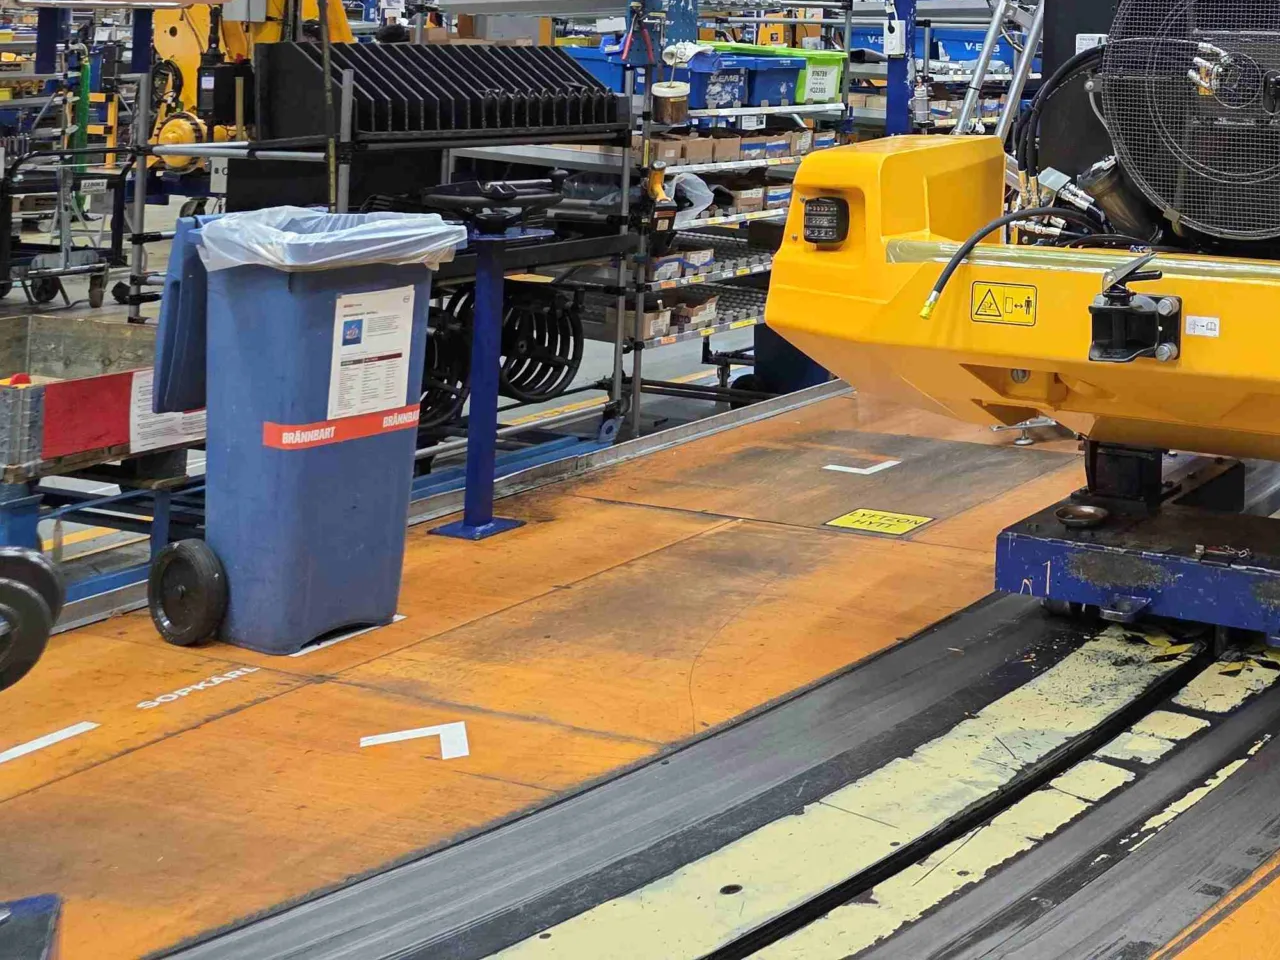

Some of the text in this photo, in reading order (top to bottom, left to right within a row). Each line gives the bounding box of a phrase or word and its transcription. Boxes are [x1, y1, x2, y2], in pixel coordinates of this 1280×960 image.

[281, 426, 336, 444] BRÄNNBART
[848, 512, 924, 525] LYFTZON
[851, 519, 897, 529] HYTT
[135, 667, 261, 709] SOPKÄRL
